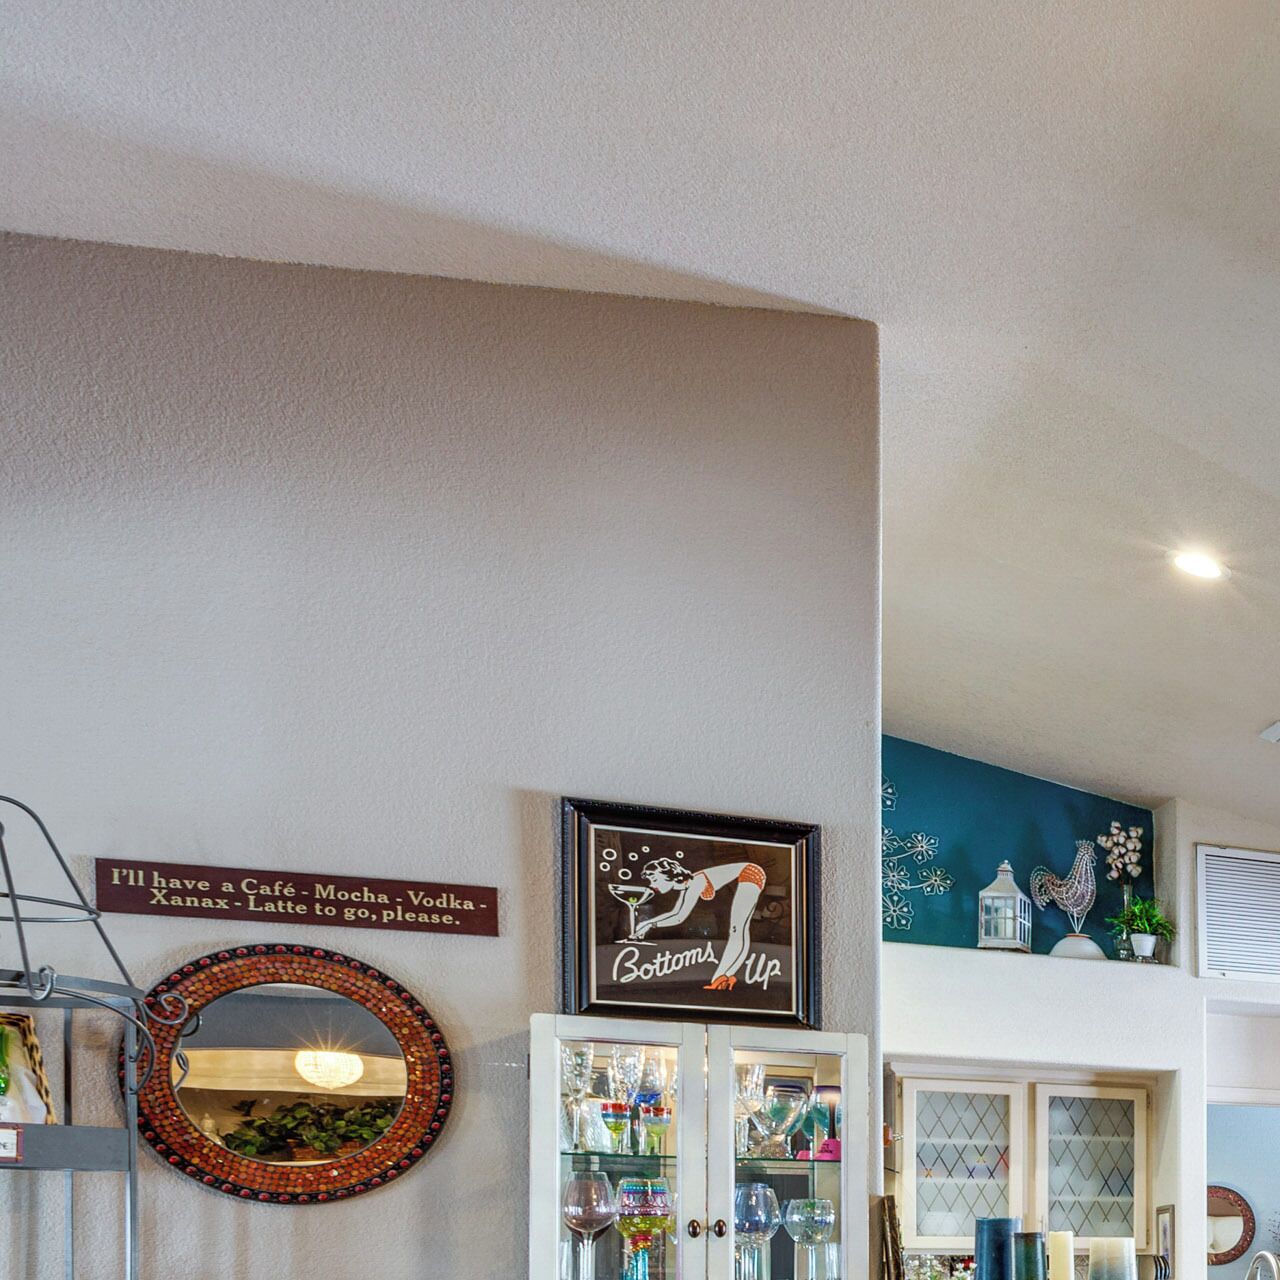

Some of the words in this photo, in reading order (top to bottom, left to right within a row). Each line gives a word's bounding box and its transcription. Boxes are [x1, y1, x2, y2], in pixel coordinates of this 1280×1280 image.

[112, 868, 145, 886] I'll
[152, 871, 210, 891] have
[221, 881, 236, 893] a
[241, 878, 296, 897] Café
[314, 883, 390, 904] Mocha
[407, 890, 475, 910] Vodka
[150, 888, 230, 909] Xanax
[247, 895, 308, 914] Latte
[314, 902, 337, 916] to
[343, 907, 377, 921] go,
[382, 905, 460, 925] please.
[612, 941, 719, 984] Bottoms
[744, 953, 781, 991] Up
